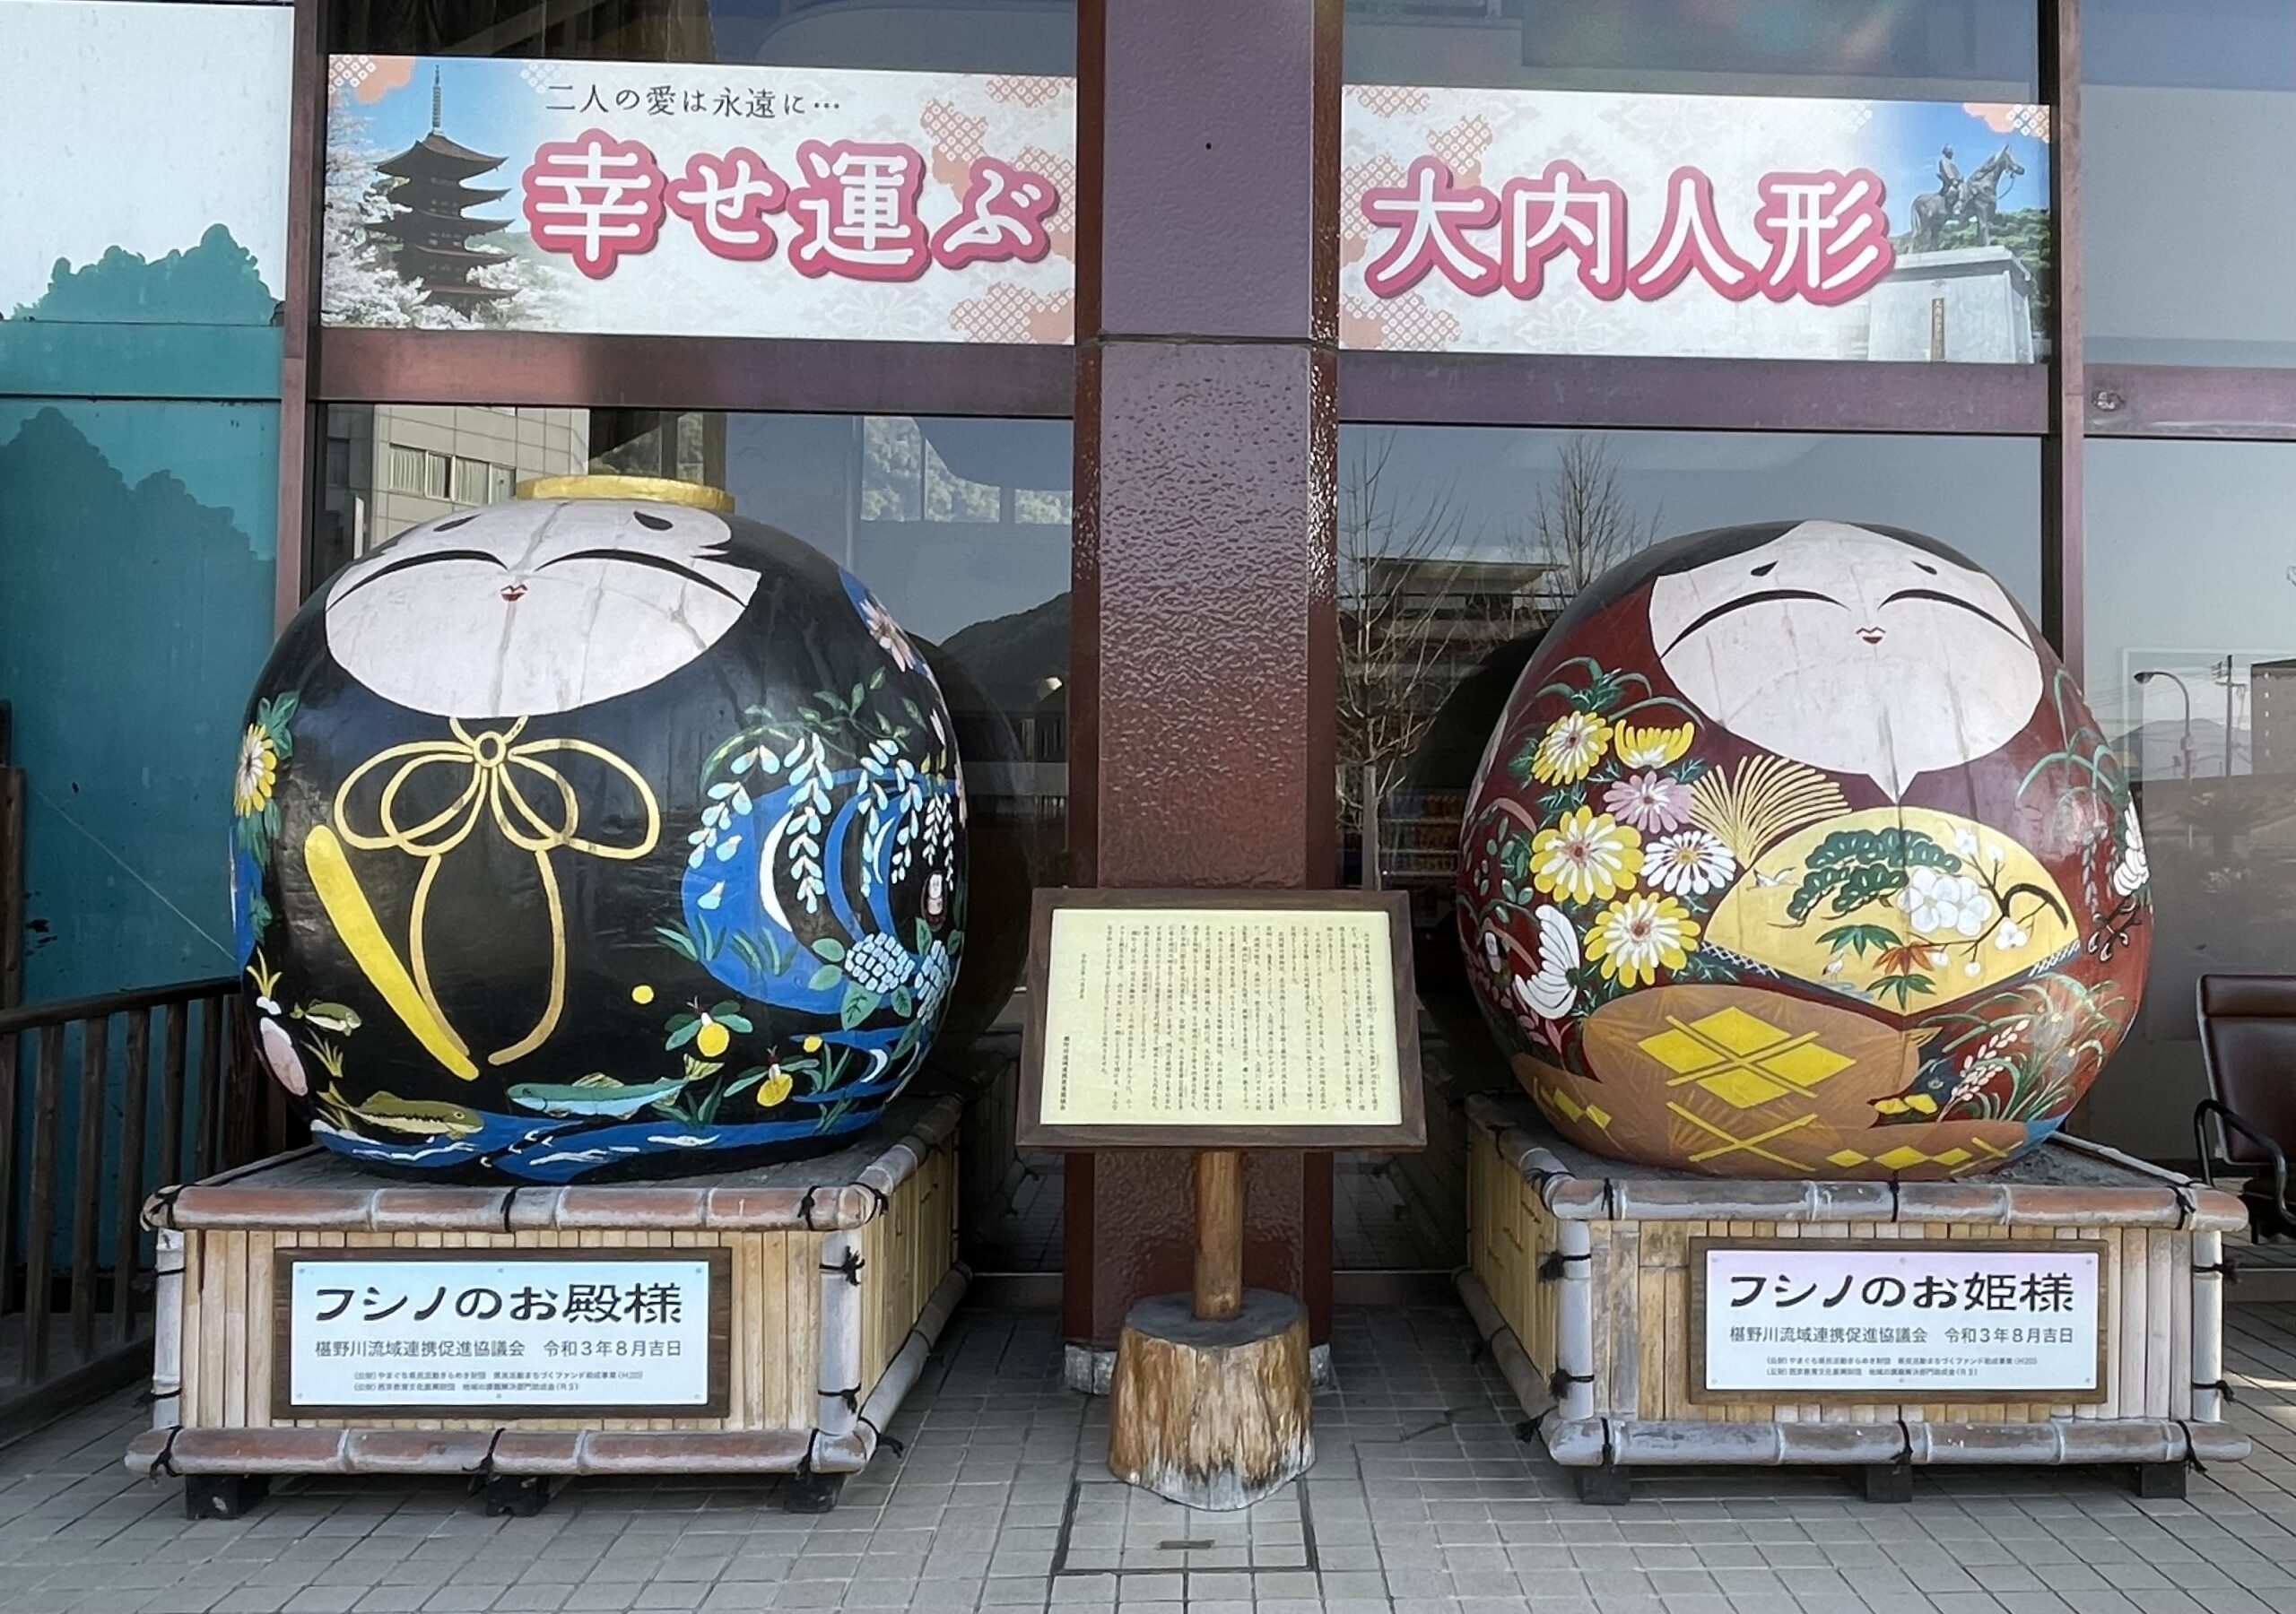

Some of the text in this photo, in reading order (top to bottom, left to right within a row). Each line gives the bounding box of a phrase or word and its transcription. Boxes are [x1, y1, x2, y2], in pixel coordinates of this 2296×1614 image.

[545, 83, 839, 118] 二人の愛は永遠に…
[527, 134, 1051, 273] 幸せ運ぶ
[1367, 161, 1889, 298] 大内人形
[315, 1280, 683, 1324] フシノのお殿様
[1729, 1270, 2074, 1313] フシノのお姫様
[543, 1338, 683, 1358] 令和3年8月吉日
[1944, 1324, 2074, 1344] 令和3年8月吉日
